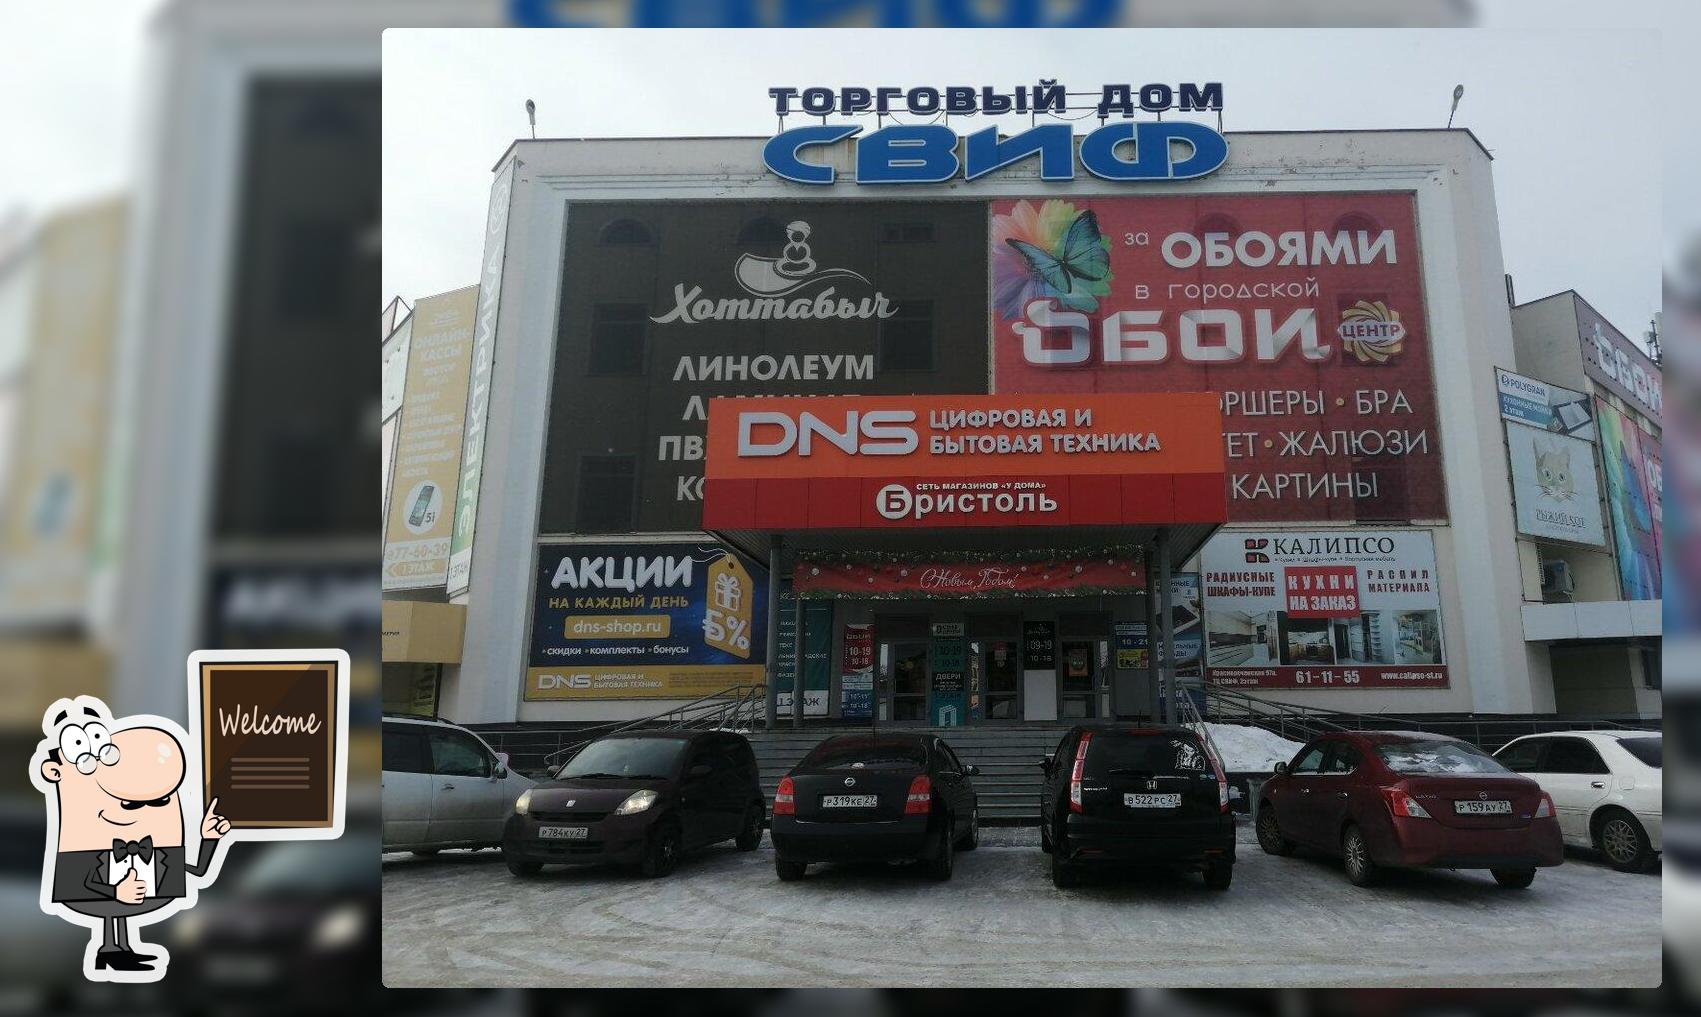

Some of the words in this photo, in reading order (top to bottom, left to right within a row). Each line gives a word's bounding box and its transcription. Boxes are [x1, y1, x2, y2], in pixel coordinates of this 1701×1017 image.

[768, 78, 1067, 117] ТОРГОВЫЙ
[1097, 82, 1223, 118] ДОМ
[762, 121, 1230, 185] СВИФ
[1123, 231, 1150, 247] за
[1160, 229, 1398, 269] ОБОЯМИ
[649, 282, 900, 324] Хоттабыч
[1341, 322, 1402, 341] ЦЕНТР
[672, 353, 875, 381] ЛИНОЛЕУМ
[1220, 389, 1326, 416] РШЕРЫ
[1355, 388, 1414, 415] БРА
[929, 408, 1068, 432] ЦИФРОВАЯ
[1073, 407, 1093, 428] И
[737, 410, 920, 457] DNS
[929, 434, 1043, 455] БЫТОВАЯ
[1049, 432, 1162, 453] ТЕХНИКА
[1222, 431, 1259, 458] ЕТ
[1278, 429, 1429, 457] ЖАЛЮЗИ
[915, 482, 941, 491] СЕТЬ
[942, 481, 999, 490] МАГАЗИНОВ
[1231, 471, 1379, 500] КАРТИНЫ
[1272, 536, 1396, 555] КАЛИПСО
[550, 555, 694, 593] АКЦИИ
[1206, 571, 1275, 583] РАДИУСНЫЕ
[1207, 585, 1277, 597] ШКАФЫ-КУПЕ
[1368, 582, 1431, 593] МАТЕРИАЛА
[548, 598, 569, 609] НА
[574, 594, 645, 609] КАЖДЫЙ
[650, 596, 689, 609] ДЕНЬ
[1289, 597, 1308, 611] НА
[1310, 595, 1357, 611] ЗАКАЗ
[573, 619, 662, 635] dns-shop.ru
[546, 647, 582, 657] скидки
[589, 646, 645, 656] комплекты
[653, 644, 690, 656] бонусы
[537, 673, 593, 690] DNS
[592, 681, 629, 690] БЫТОВАЯ
[629, 680, 664, 689] ТЕХНИКА
[594, 673, 637, 682] ЦИФРОВАЯ
[1295, 670, 1360, 684] 61-11-55
